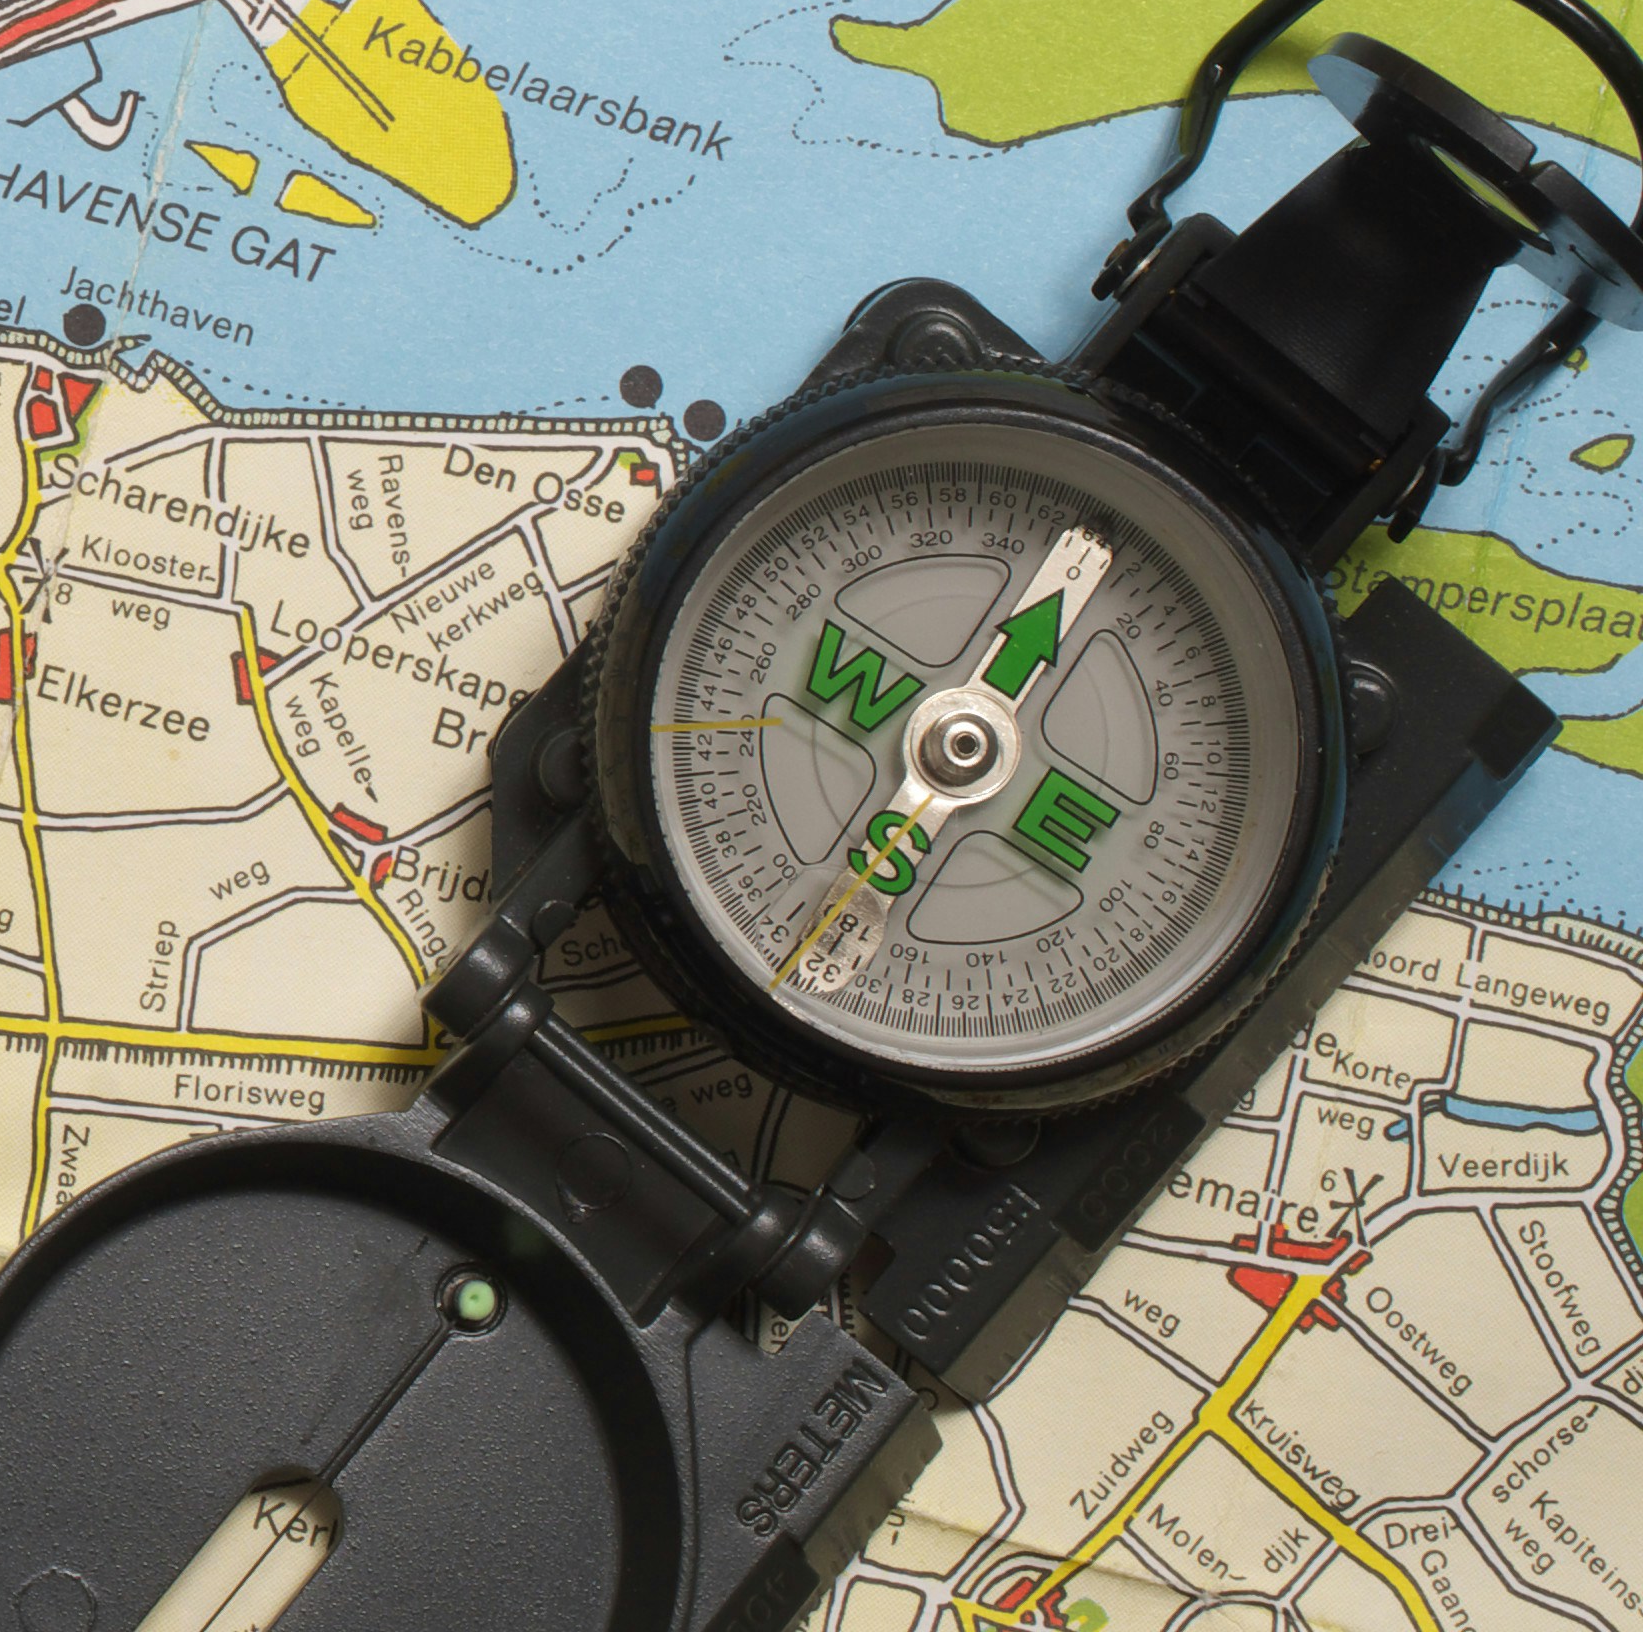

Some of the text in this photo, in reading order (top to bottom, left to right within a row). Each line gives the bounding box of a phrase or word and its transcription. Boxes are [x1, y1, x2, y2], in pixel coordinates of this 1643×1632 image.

[363, 16, 734, 162] Kabbelaarsbank
[230, 224, 337, 285] GAT
[59, 266, 257, 347] Jachthaven
[49, 453, 311, 559] Scharendijke
[443, 447, 627, 524] Den Osse
[937, 485, 969, 506] 58
[987, 487, 1019, 512] 60
[839, 542, 884, 577] 300
[908, 527, 955, 551] 320
[980, 528, 1027, 557] 340
[388, 561, 497, 634] Nieuwe
[426, 571, 546, 654] kerkweg
[784, 580, 824, 623] 280
[748, 638, 779, 686] 260
[805, 617, 929, 735] W
[36, 664, 211, 742] Elkerzee
[845, 808, 933, 898] S
[1011, 765, 1122, 875] E
[140, 918, 180, 1013] Striep
[1454, 960, 1614, 1026] Langeweg
[173, 1073, 327, 1115] Florisweg
[1436, 1151, 1571, 1184] Veerdijk
[1518, 1217, 1604, 1360] Stoofweg
[1365, 1284, 1476, 1399] Oostweg
[735, 1353, 891, 1540] METERS
[1069, 1408, 1176, 1520] Zuidweg
[1240, 1398, 1361, 1512] Kruisweg
